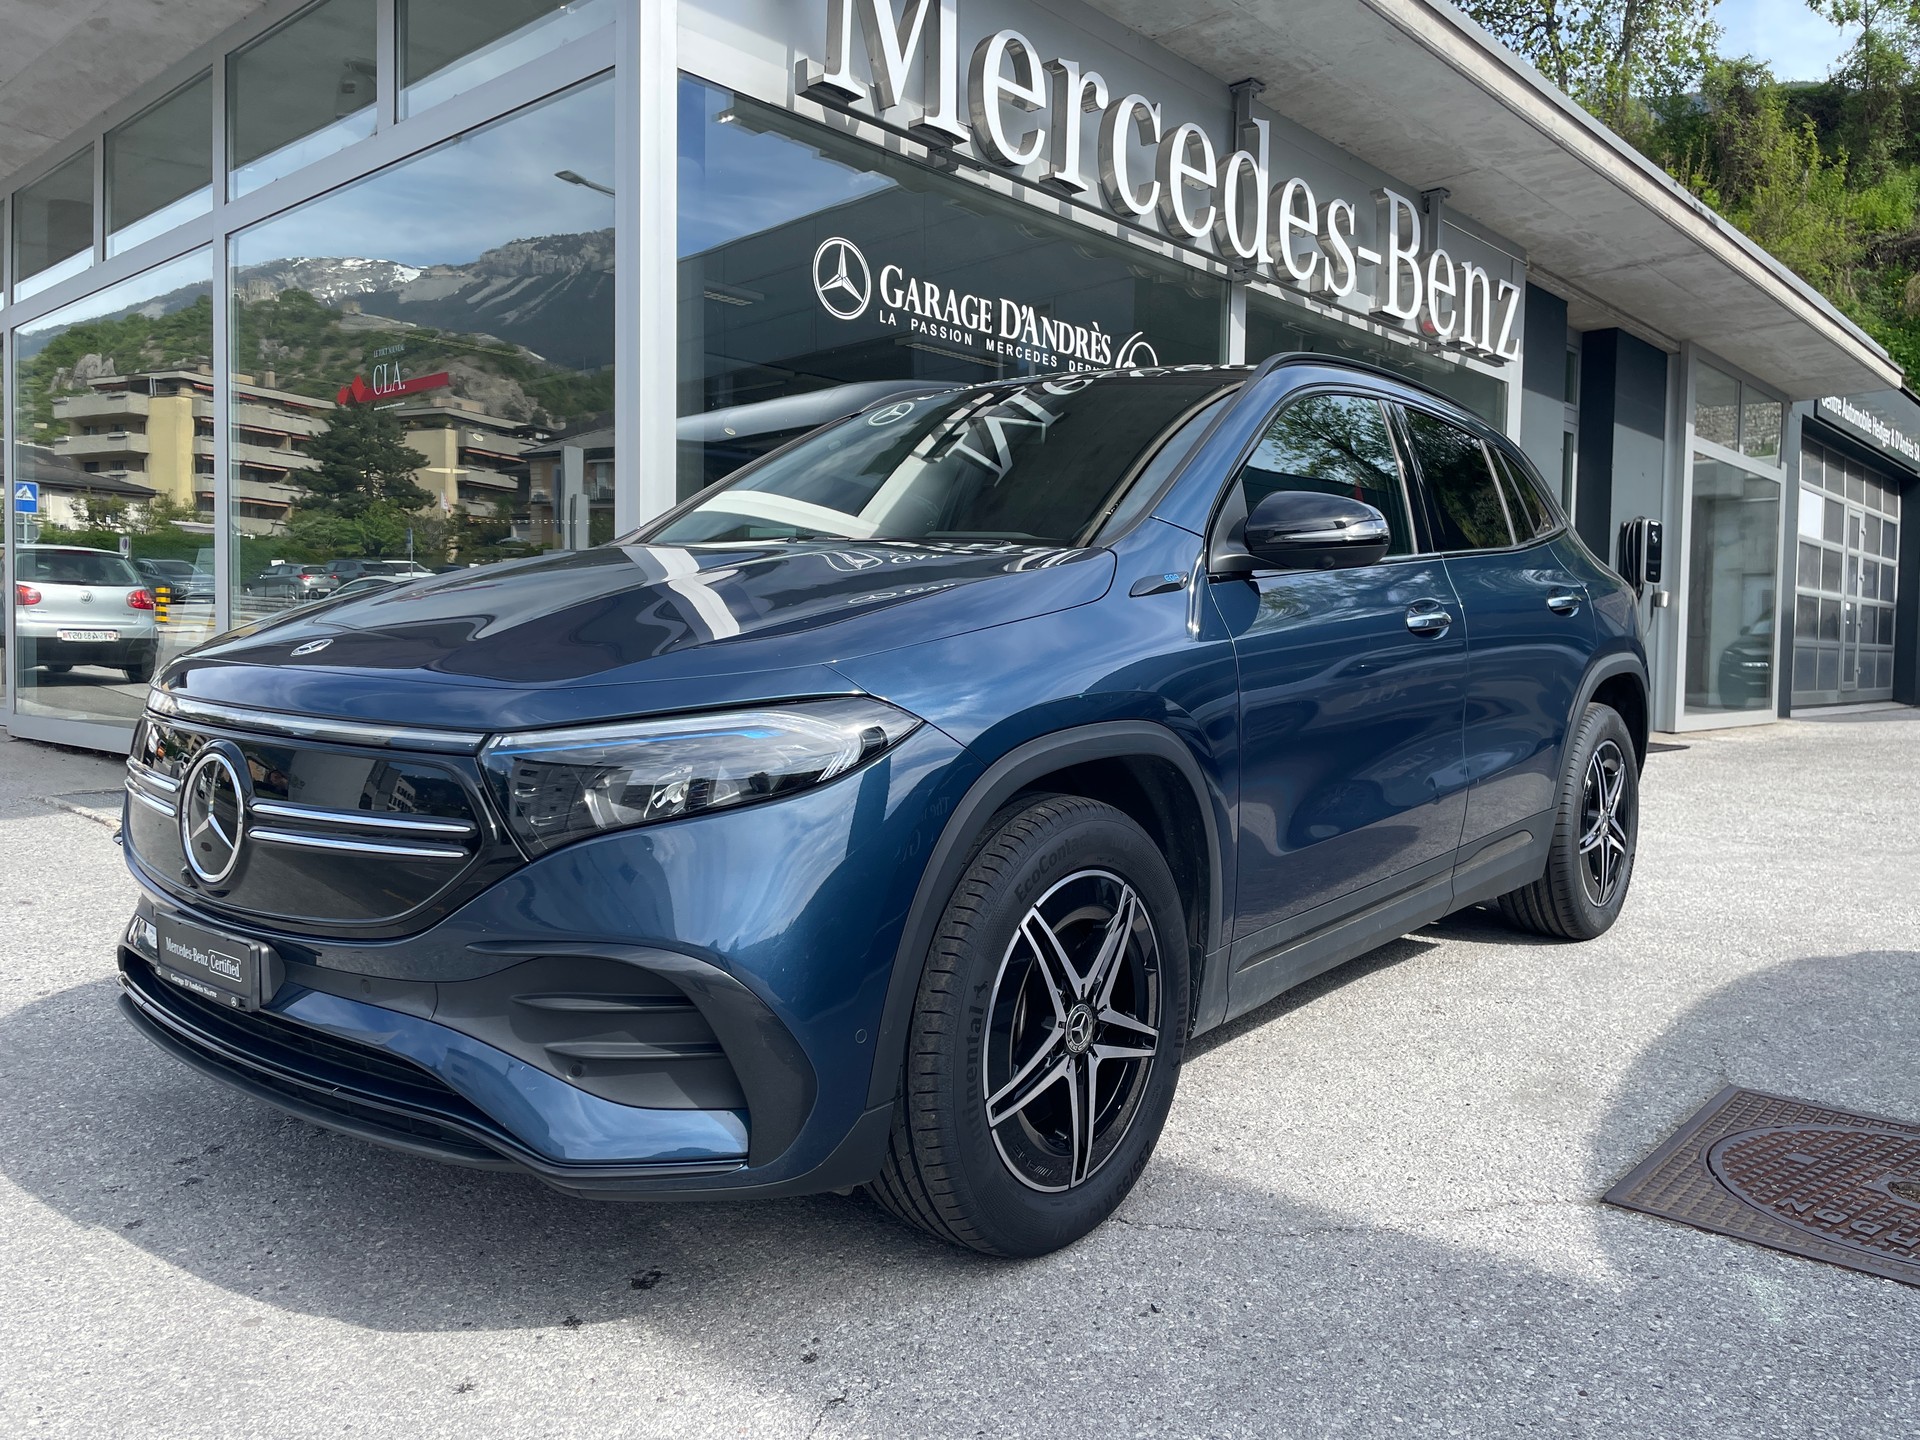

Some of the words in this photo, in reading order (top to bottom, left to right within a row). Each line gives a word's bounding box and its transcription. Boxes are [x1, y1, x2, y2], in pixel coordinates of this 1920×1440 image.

[797, 0, 1522, 362] Mercedes-Benz
[879, 264, 992, 334] GARAGE
[999, 297, 1111, 365] D'ANDRÈS
[879, 310, 897, 326] LA
[911, 318, 973, 345] PASSION
[986, 339, 1057, 368] MERCEDES
[1842, 397, 1872, 434] Automobile
[1013, 832, 1092, 905] EcoContac
[165, 936, 209, 967] Mercedes-Benz
[210, 954, 240, 978] Certified
